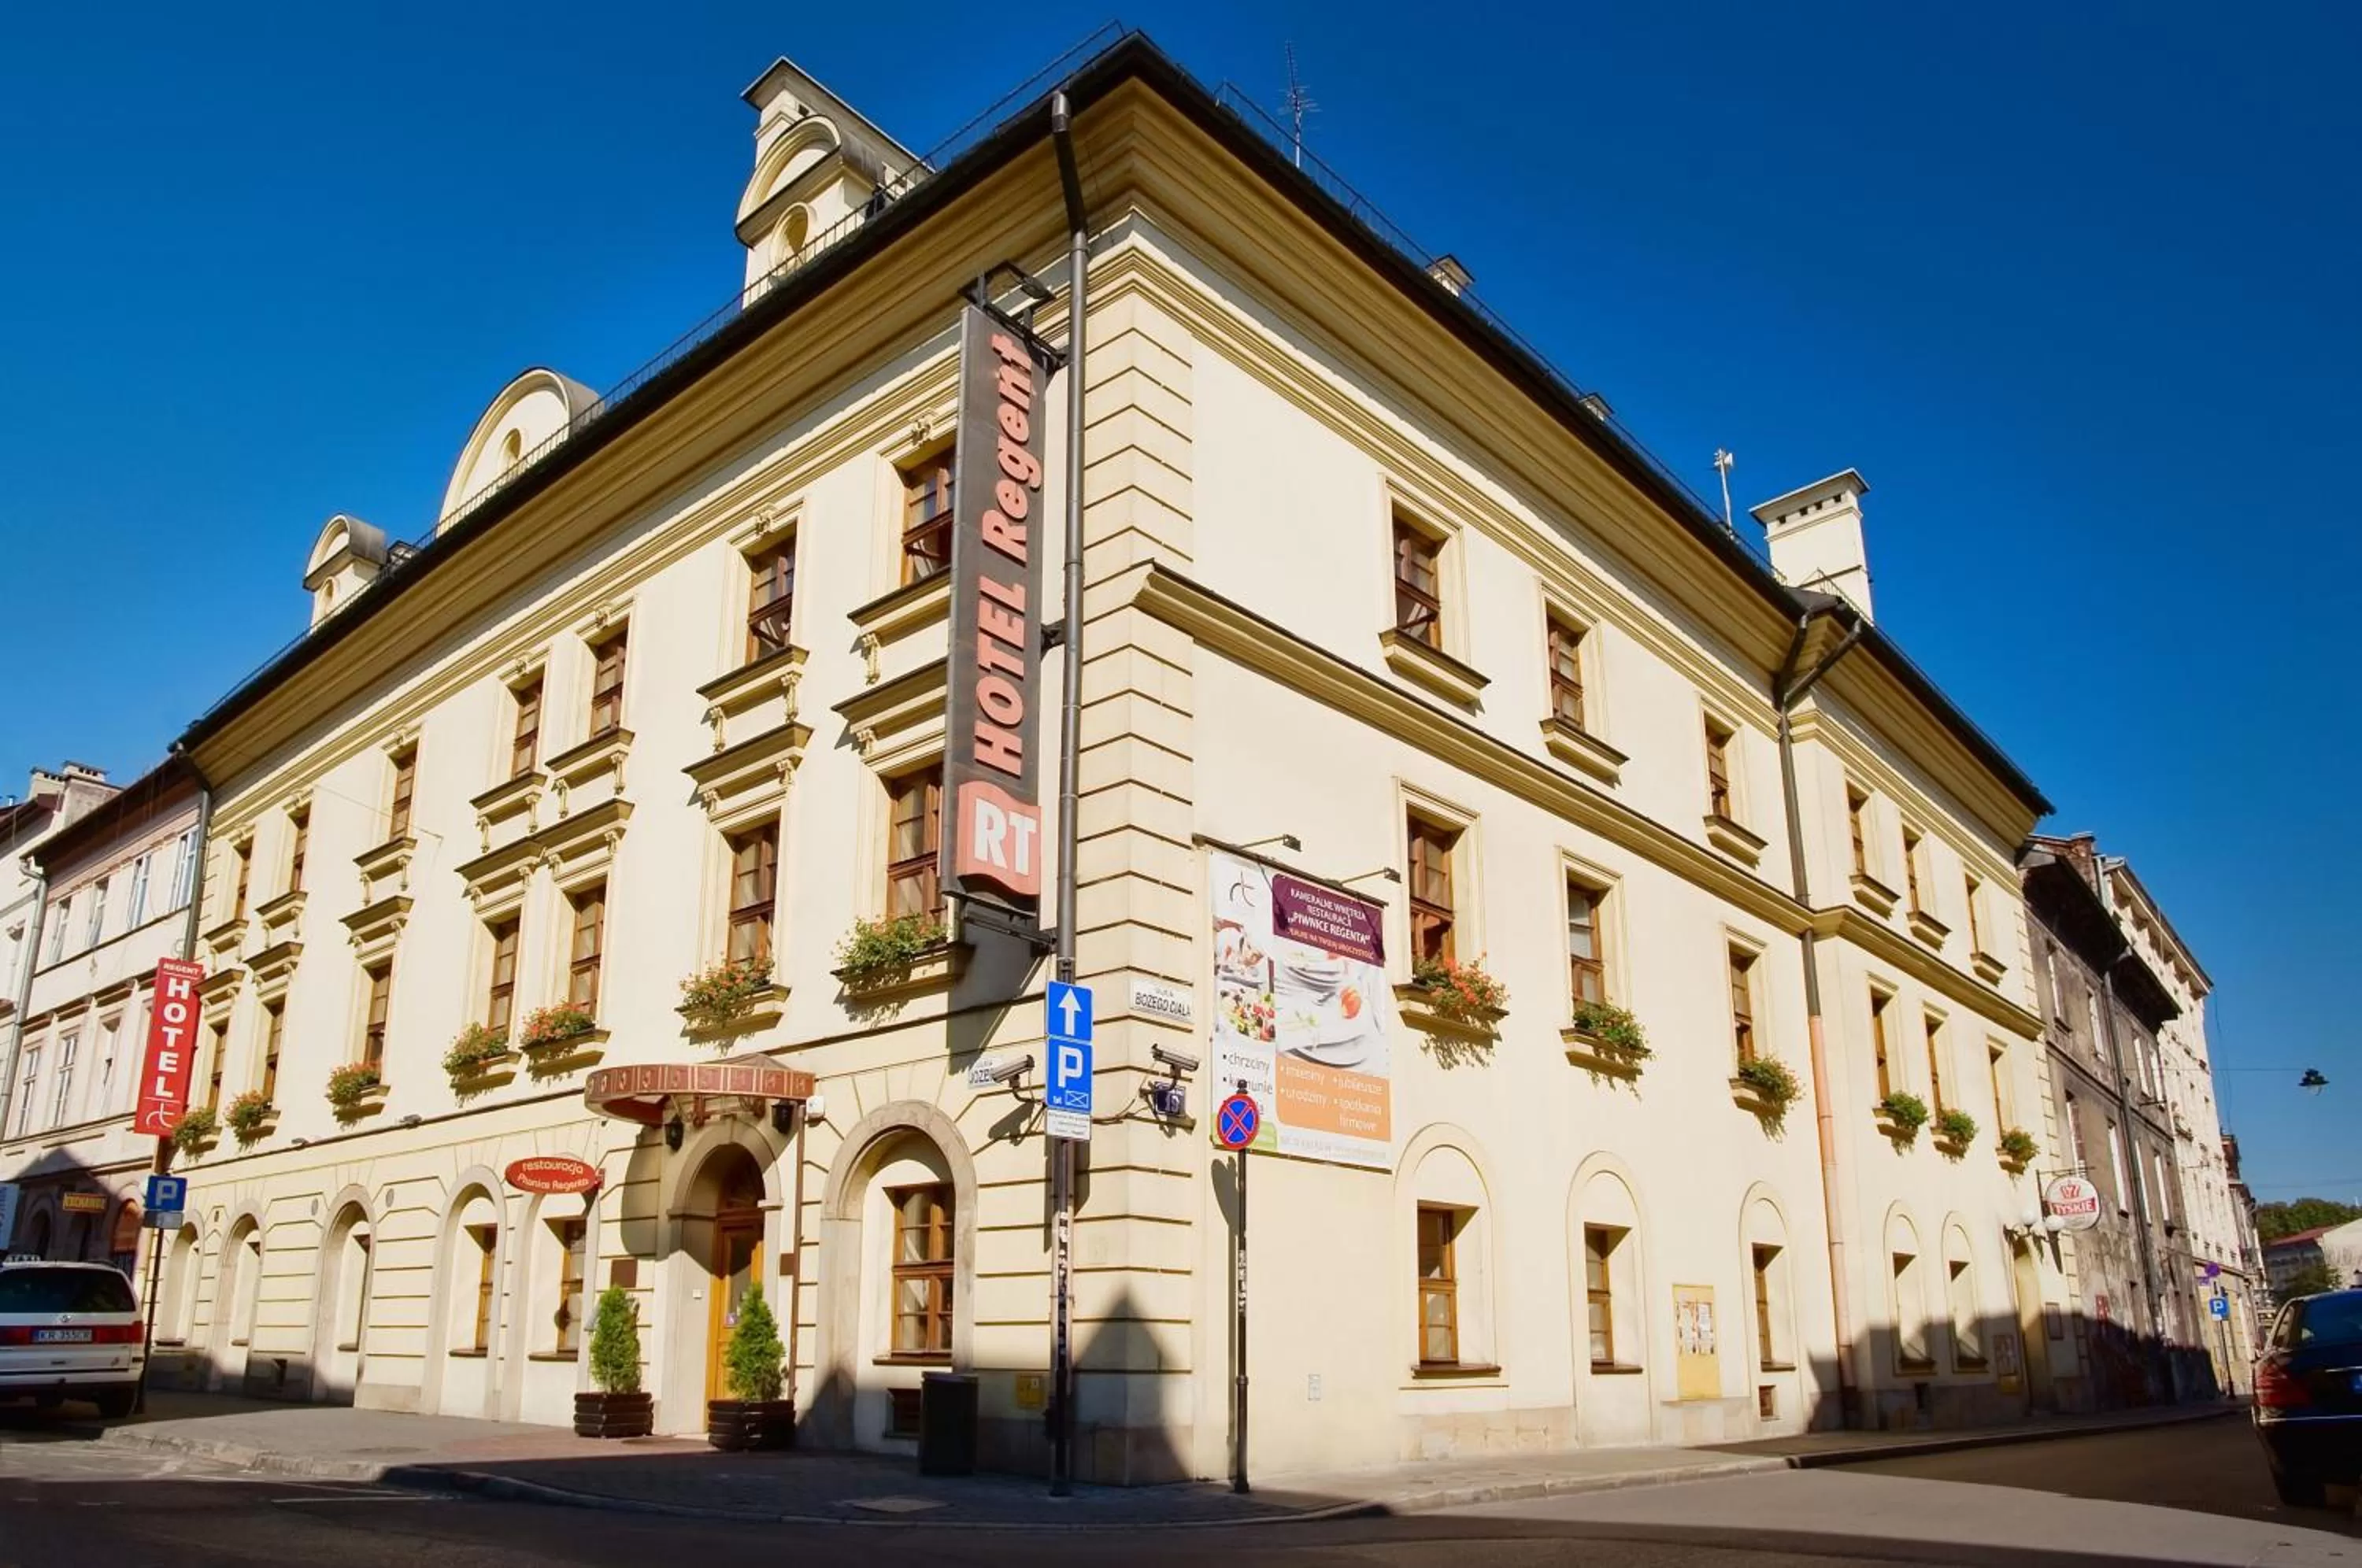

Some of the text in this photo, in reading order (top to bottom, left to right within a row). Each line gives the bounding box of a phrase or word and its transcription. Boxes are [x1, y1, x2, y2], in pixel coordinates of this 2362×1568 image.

[974, 334, 1041, 778] HOTEL Regent
[975, 797, 1037, 875] RT
[164, 962, 199, 974] REGENT
[155, 977, 191, 1098] HOTEL
[1058, 1045, 1083, 1088] P
[522, 1159, 583, 1175] restauracja
[154, 1180, 179, 1207] P
[2054, 1200, 2093, 1215] TYSKIE
[2213, 1300, 2224, 1312] P
